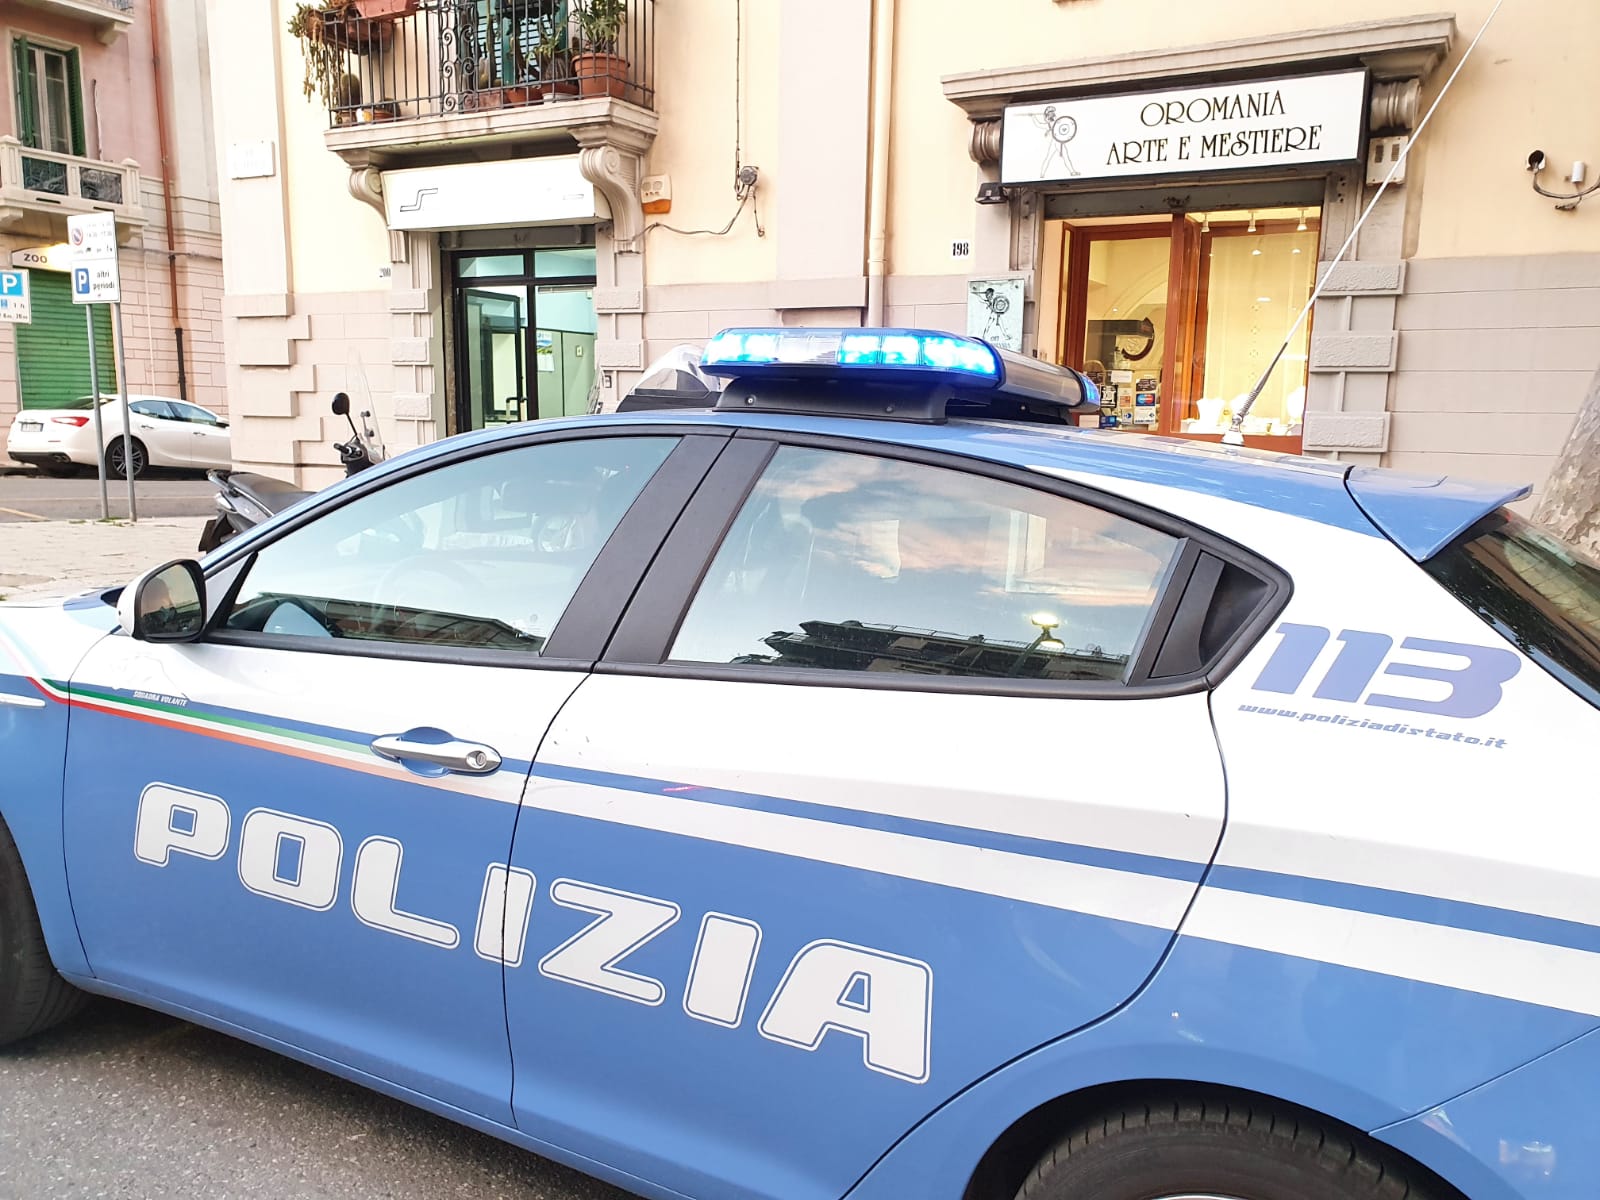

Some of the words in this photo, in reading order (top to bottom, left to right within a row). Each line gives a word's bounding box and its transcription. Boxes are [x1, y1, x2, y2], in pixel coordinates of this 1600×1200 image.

[1140, 89, 1287, 127] OROMANIA
[1106, 137, 1168, 166] ARTE
[1178, 135, 1191, 161] E
[1201, 125, 1322, 160] MESTIERE
[23, 253, 48, 264] ZOO
[952, 242, 969, 256] 198
[2, 274, 18, 294] P
[78, 269, 88, 292] P
[96, 270, 110, 279] altri
[92, 280, 115, 291] periodi
[1250, 622, 1522, 719] 113
[132, 690, 160, 701] SQUADRA
[160, 695, 188, 706] VOLANTE
[1238, 703, 1508, 749] www.poliziadistato.it
[133, 780, 934, 1085] POLIZIA
